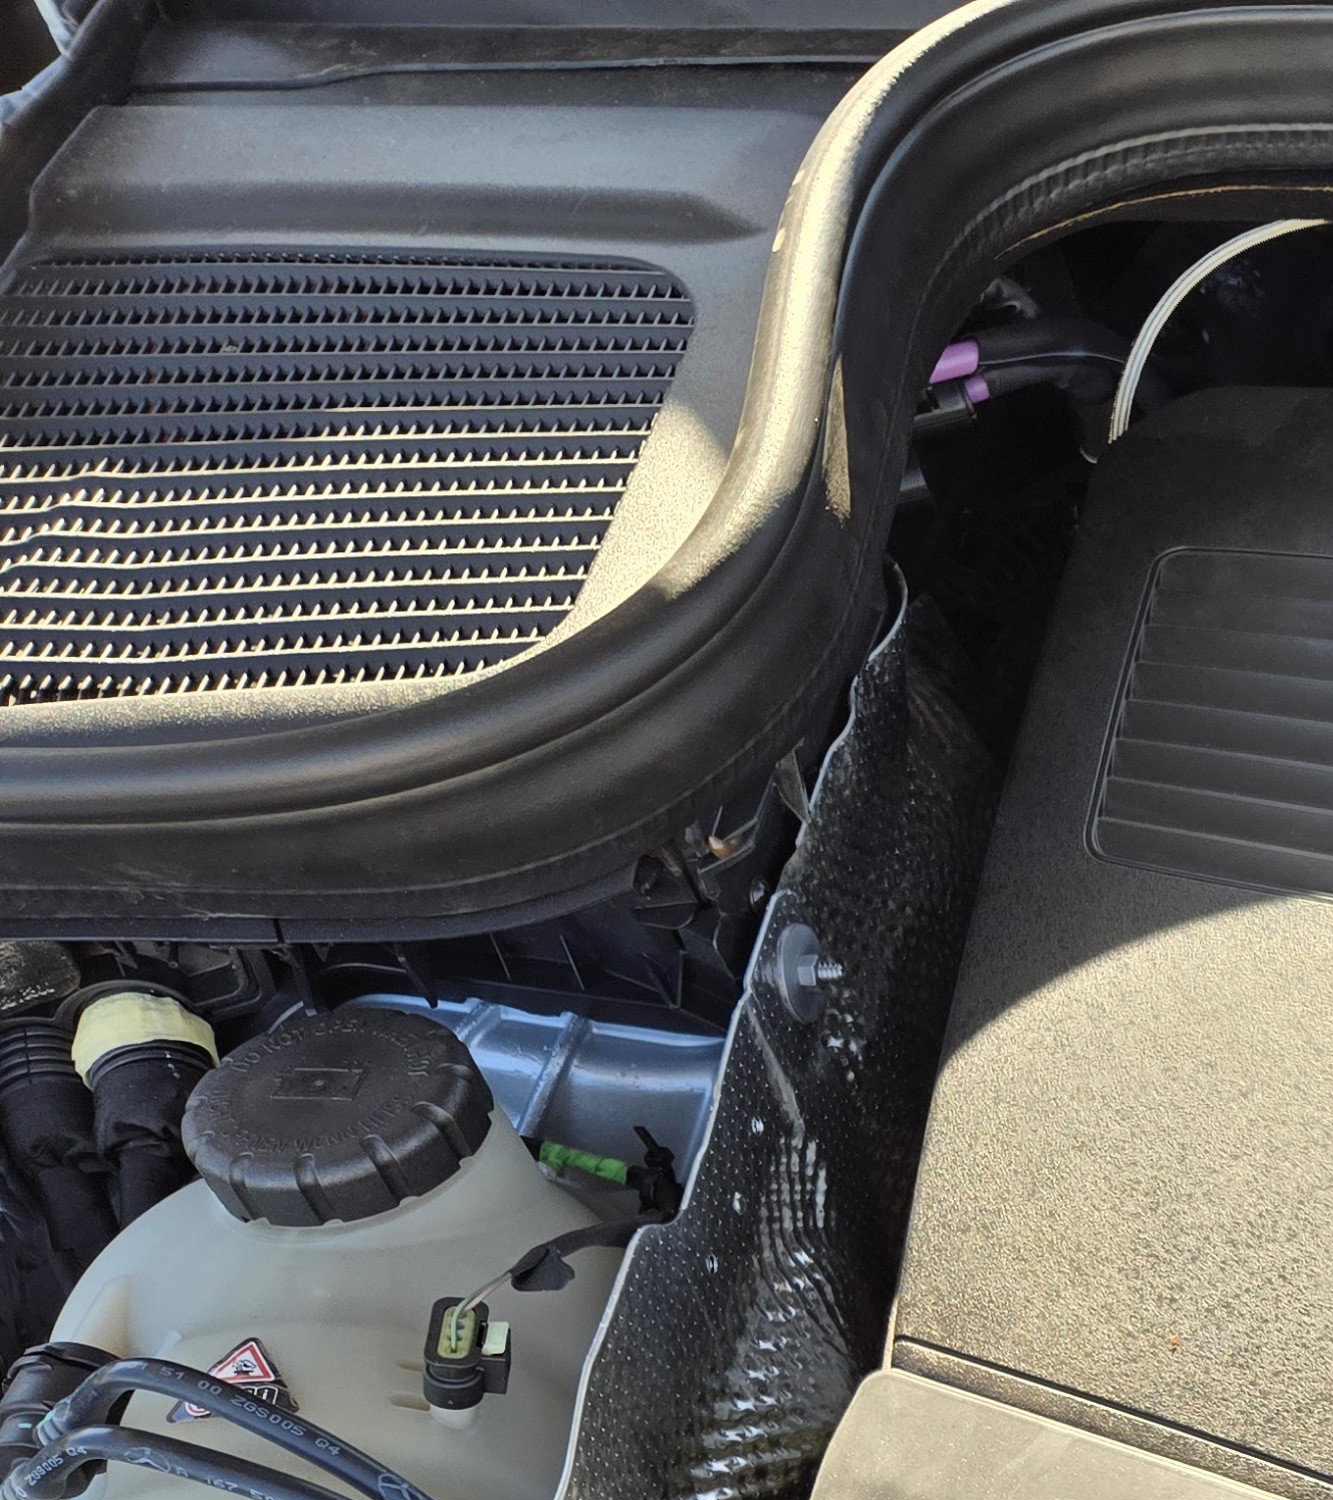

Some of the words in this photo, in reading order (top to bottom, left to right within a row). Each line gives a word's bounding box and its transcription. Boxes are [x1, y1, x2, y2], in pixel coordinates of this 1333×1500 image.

[160, 1367, 184, 1380] 51
[197, 1380, 222, 1395] 00
[231, 1396, 304, 1436] ZGS005
[315, 1437, 340, 1456] Q4
[66, 1445, 87, 1457] Q4
